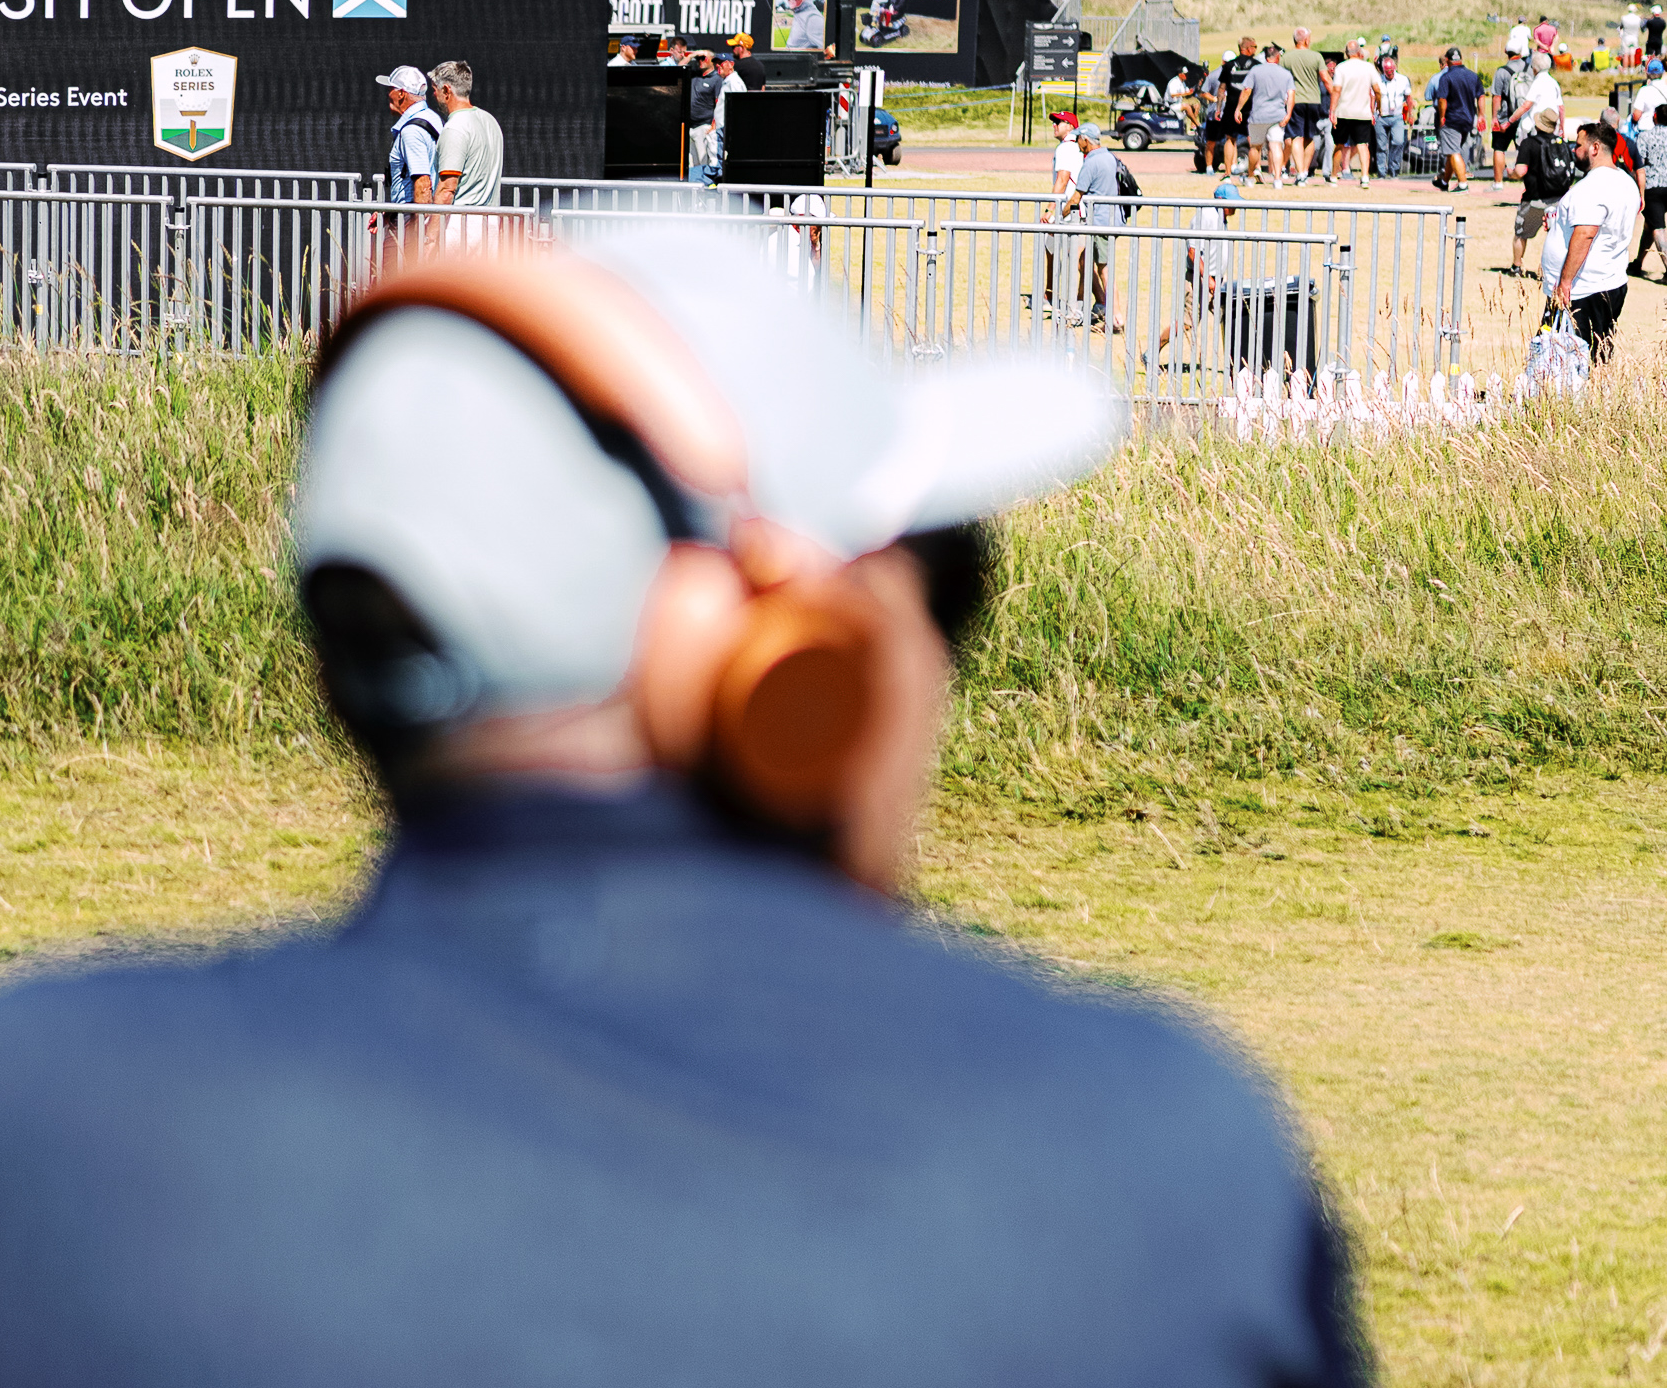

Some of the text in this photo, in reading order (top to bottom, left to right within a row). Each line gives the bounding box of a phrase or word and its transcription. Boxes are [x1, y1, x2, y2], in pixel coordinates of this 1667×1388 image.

[175, 68, 213, 78] ROLEX
[173, 81, 215, 91] SERIES
[67, 86, 128, 108] Event
